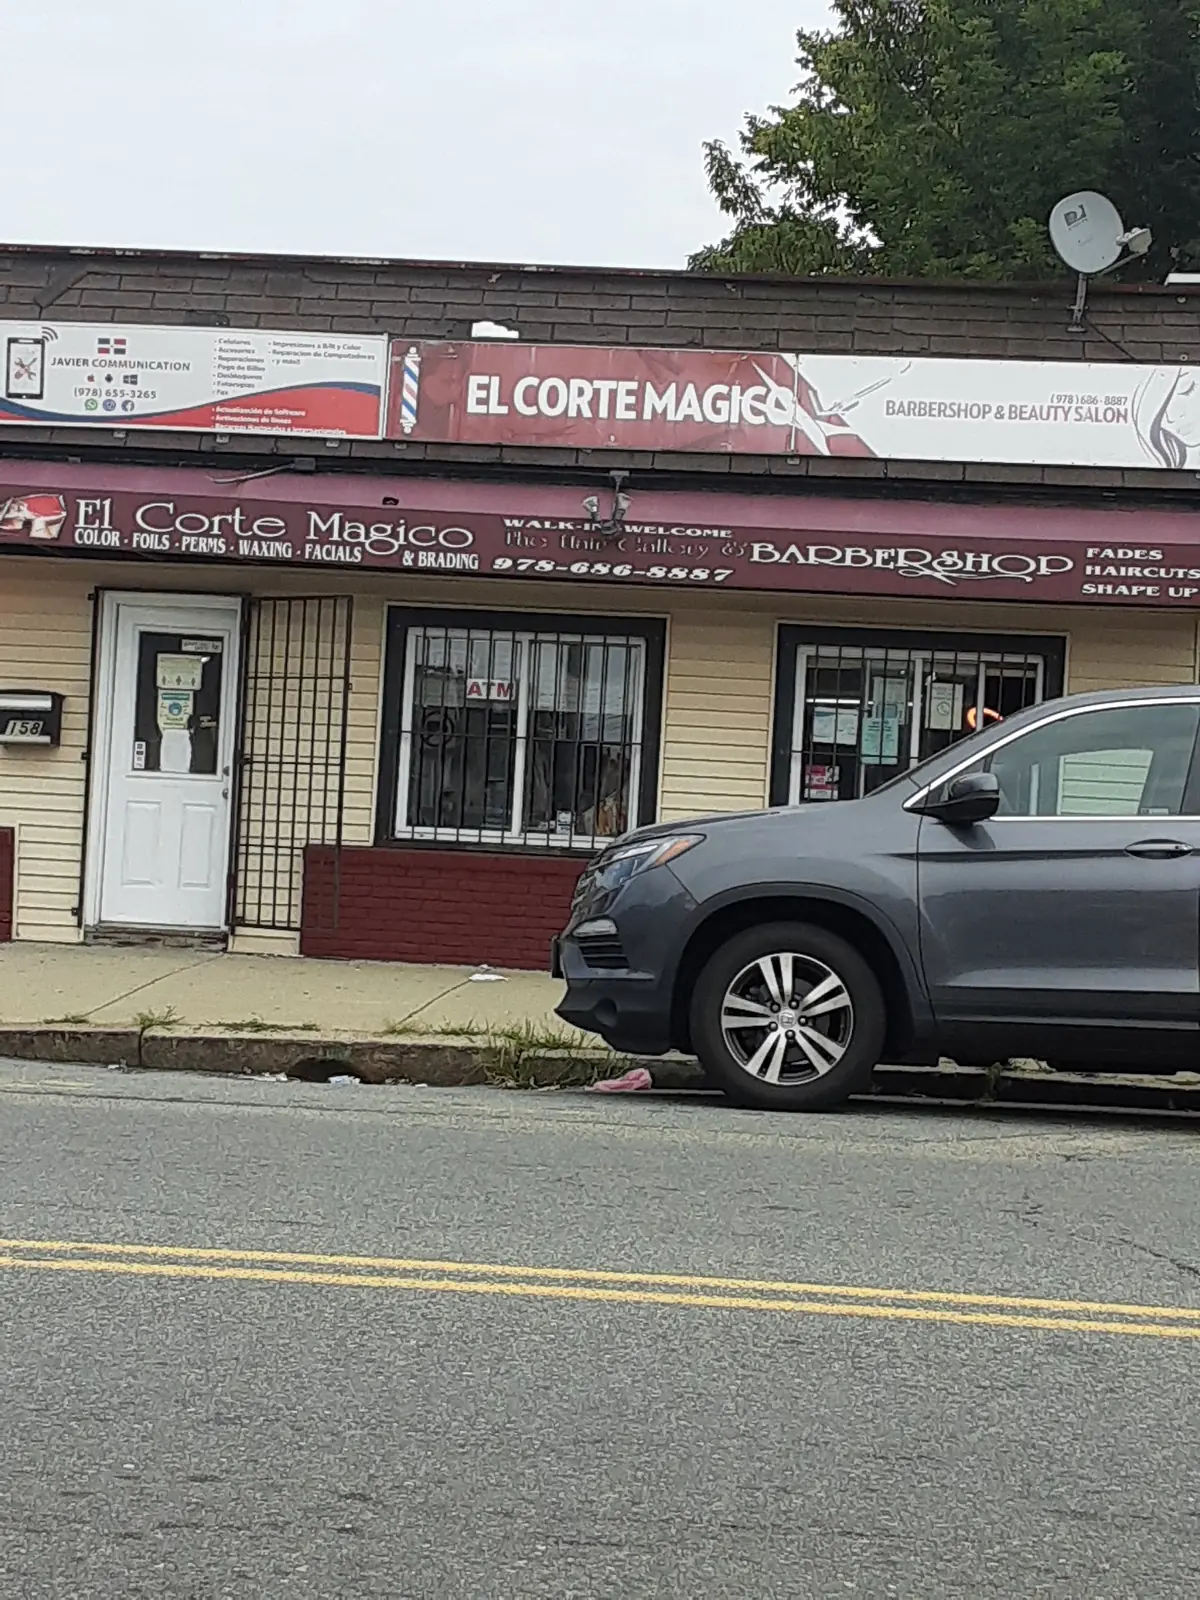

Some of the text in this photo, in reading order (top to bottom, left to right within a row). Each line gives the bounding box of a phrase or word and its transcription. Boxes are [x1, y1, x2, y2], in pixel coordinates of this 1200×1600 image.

[51, 357, 191, 371] JAVIER COMMUNICATION
[74, 387, 157, 399] (978) 655-3265
[467, 374, 796, 426] EL CORTE MAGICO
[885, 400, 1128, 423] BARBERSHOP & BEAUTY SALON
[75, 498, 473, 555] El Corte Magico
[624, 525, 733, 538] WELCOME
[74, 528, 479, 569] COLOR FOILS PERMS WAXING FACIALS & BRADING
[1086, 547, 1163, 560] FADES
[492, 557, 734, 581] 978-686-8887
[749, 542, 1074, 586] BARBERSHOP
[1085, 565, 1200, 579] HAIRCUTS
[1081, 583, 1199, 598] SHAPE UP
[467, 681, 513, 698] ATM
[10, 721, 41, 735] 158
